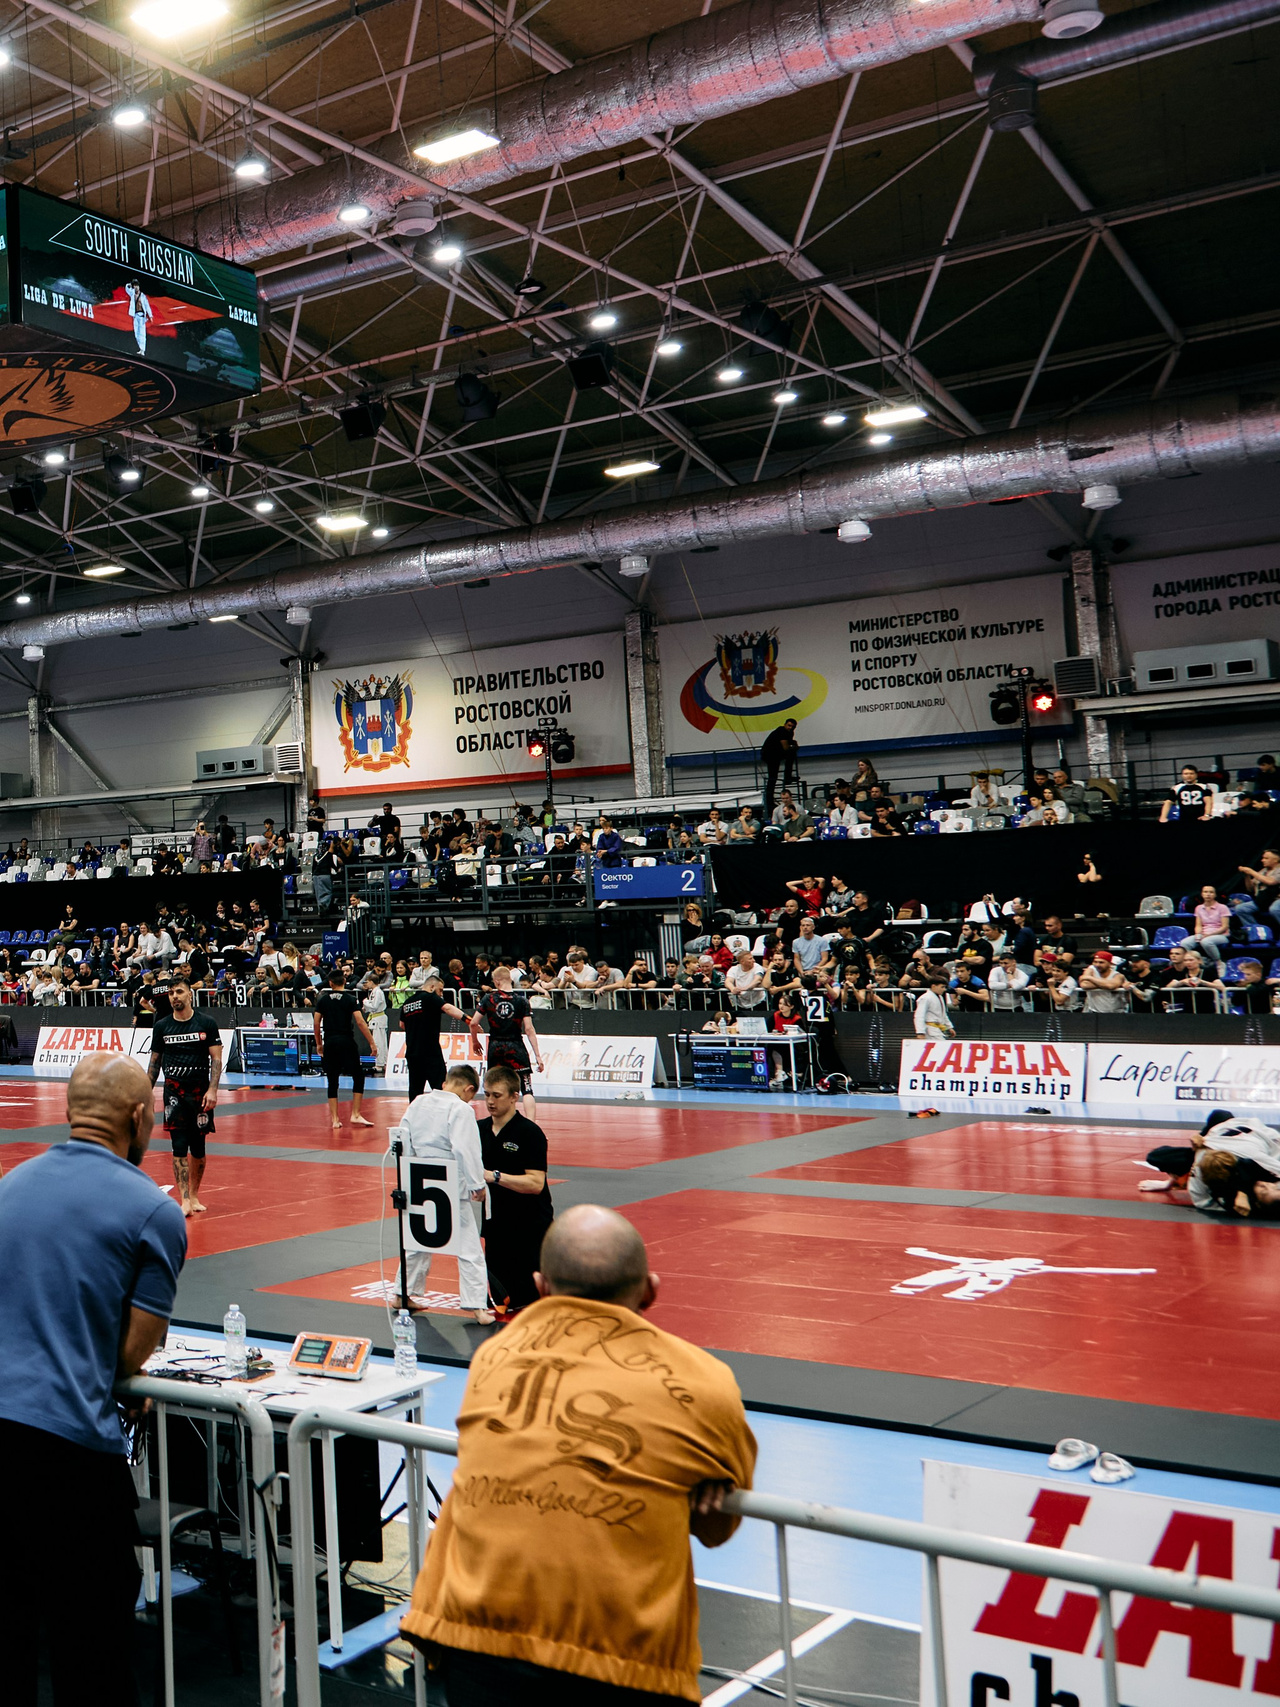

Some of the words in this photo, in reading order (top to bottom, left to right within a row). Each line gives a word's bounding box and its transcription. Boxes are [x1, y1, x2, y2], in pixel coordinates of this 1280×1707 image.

[85, 219, 129, 263] SOUTH
[139, 238, 194, 285] RUSSIAN
[23, 284, 48, 306] LIGA
[52, 292, 66, 310] DE
[70, 298, 94, 319] LUTA
[228, 305, 258, 326] LAPELA
[1154, 597, 1222, 619] ГОРОДА
[849, 608, 959, 633] МИНИСТЕРСТВО
[850, 639, 868, 653] ПО
[872, 624, 967, 651] ФИЗИЧЕСКОЙ
[970, 618, 1045, 640] КУЛЬТУРЕ
[851, 659, 861, 672] И
[864, 653, 917, 671] СПОРТУ
[453, 660, 604, 695] ПРАВИТЕЛЬСТВО
[853, 667, 941, 692] РОСТОВСКОЙ
[946, 663, 1013, 682] ОБЛАСТИ
[455, 689, 572, 725] РОСТОВСКОЙ
[854, 697, 946, 714] MINSPORT.DONLAND.RU
[1180, 790, 1203, 805] 92
[601, 873, 634, 883] Сектор
[681, 869, 696, 891] 2
[153, 984, 169, 995] REFERE
[236, 984, 246, 1003] 3
[808, 998, 821, 1019] 2
[42, 1028, 124, 1051] LAPELA
[163, 1034, 198, 1044] PITBULL
[39, 1050, 87, 1067] champi
[595, 1045, 645, 1068] Luta
[754, 1052, 765, 1060] 15
[912, 1042, 1071, 1077] LAPELA
[589, 1071, 609, 1081] 2016
[756, 1063, 764, 1074] 0
[1099, 1051, 1199, 1097] Lapela
[1207, 1057, 1280, 1084] Luta
[909, 1074, 1071, 1100] championship
[408, 1162, 453, 1248] 5
[972, 1487, 1280, 1699] LA
